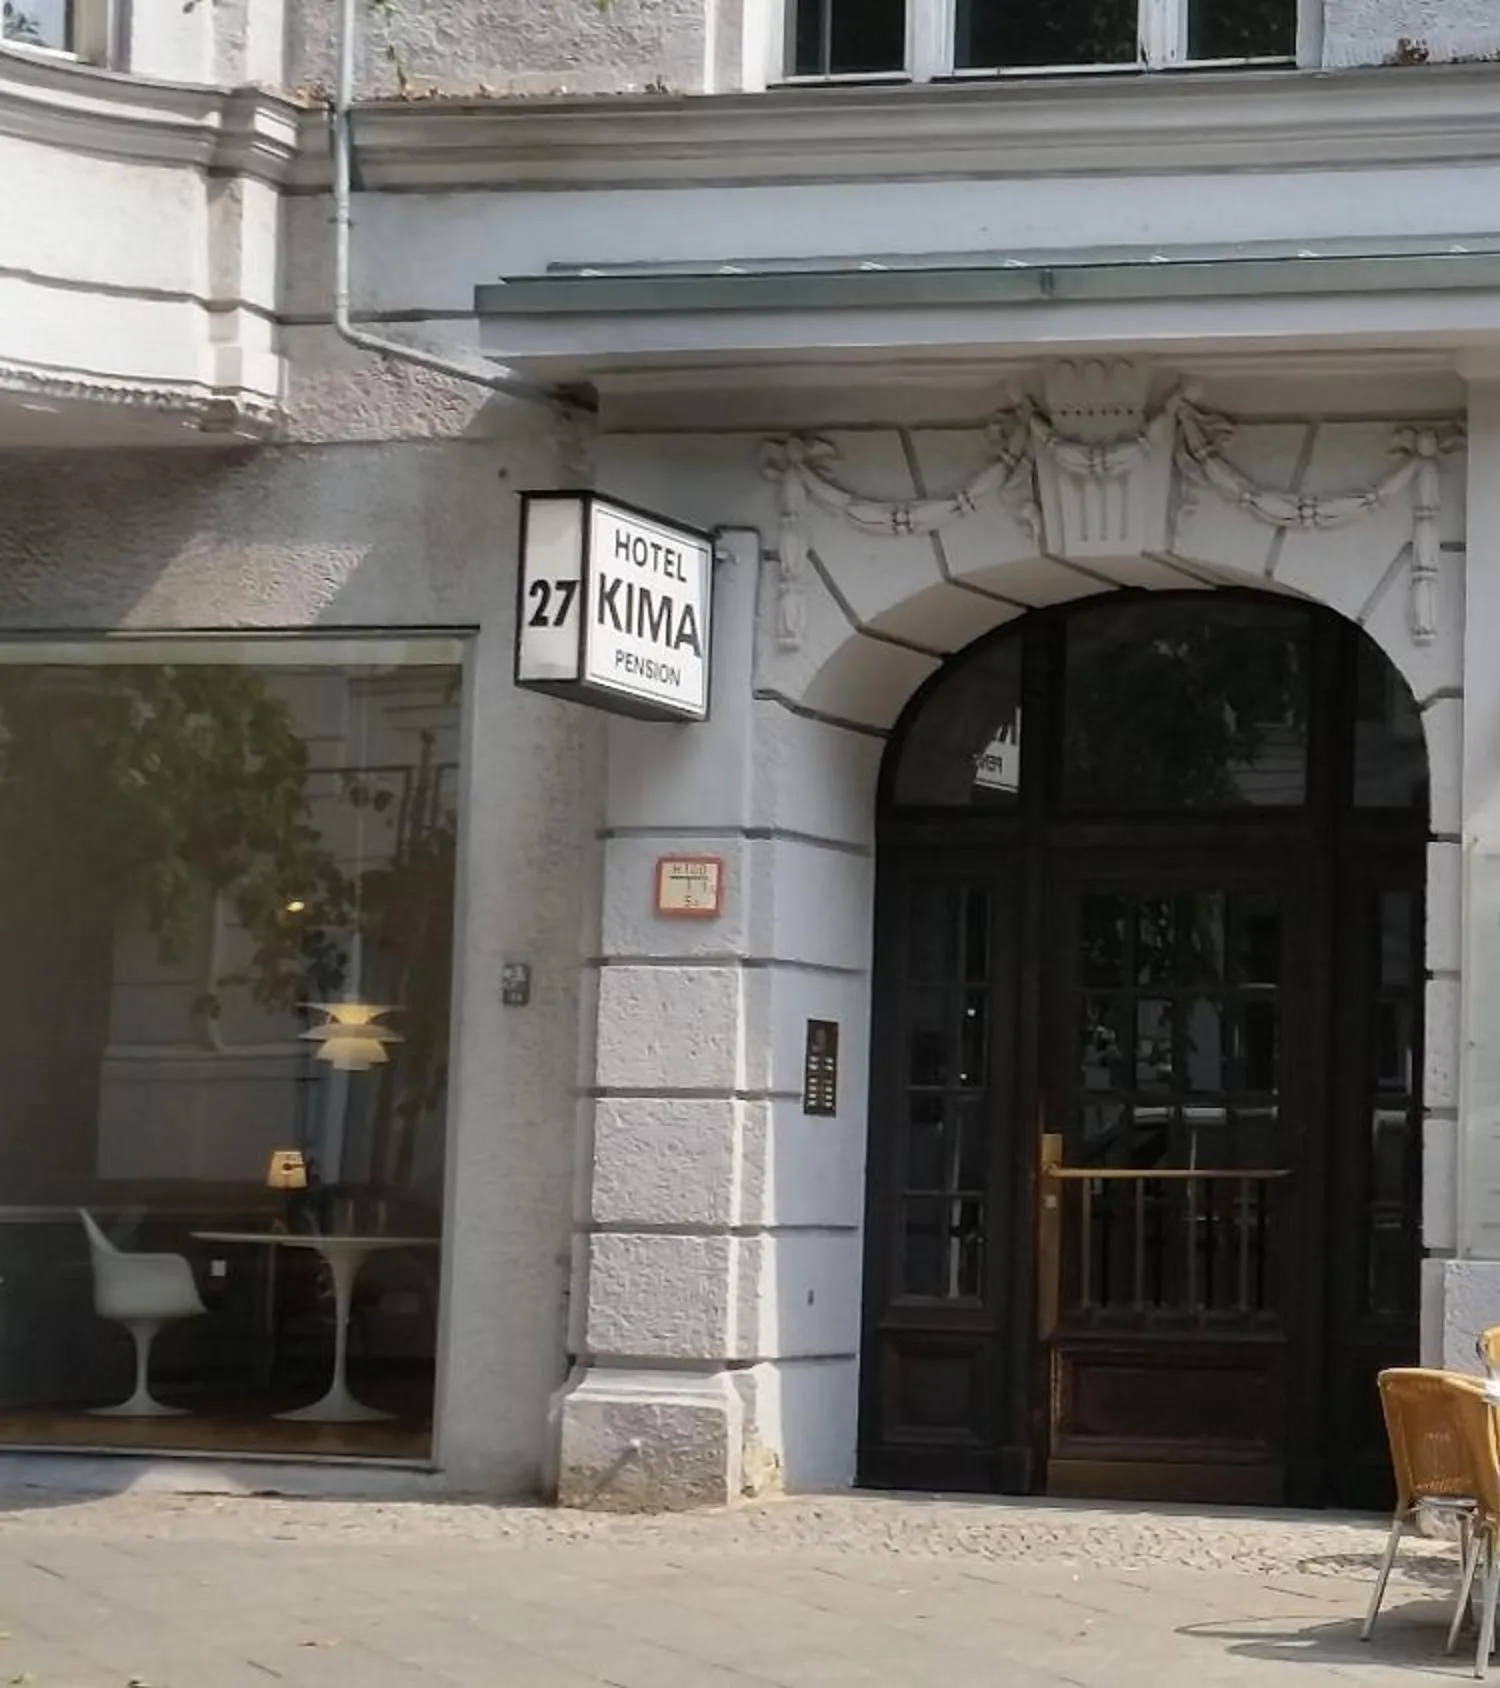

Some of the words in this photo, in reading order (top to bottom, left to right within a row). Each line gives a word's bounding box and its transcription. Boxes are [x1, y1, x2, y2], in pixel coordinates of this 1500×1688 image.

[615, 529, 687, 583] HOTEL
[528, 578, 579, 627] 27
[597, 572, 702, 658] KIMA
[615, 650, 681, 687] PENSION
